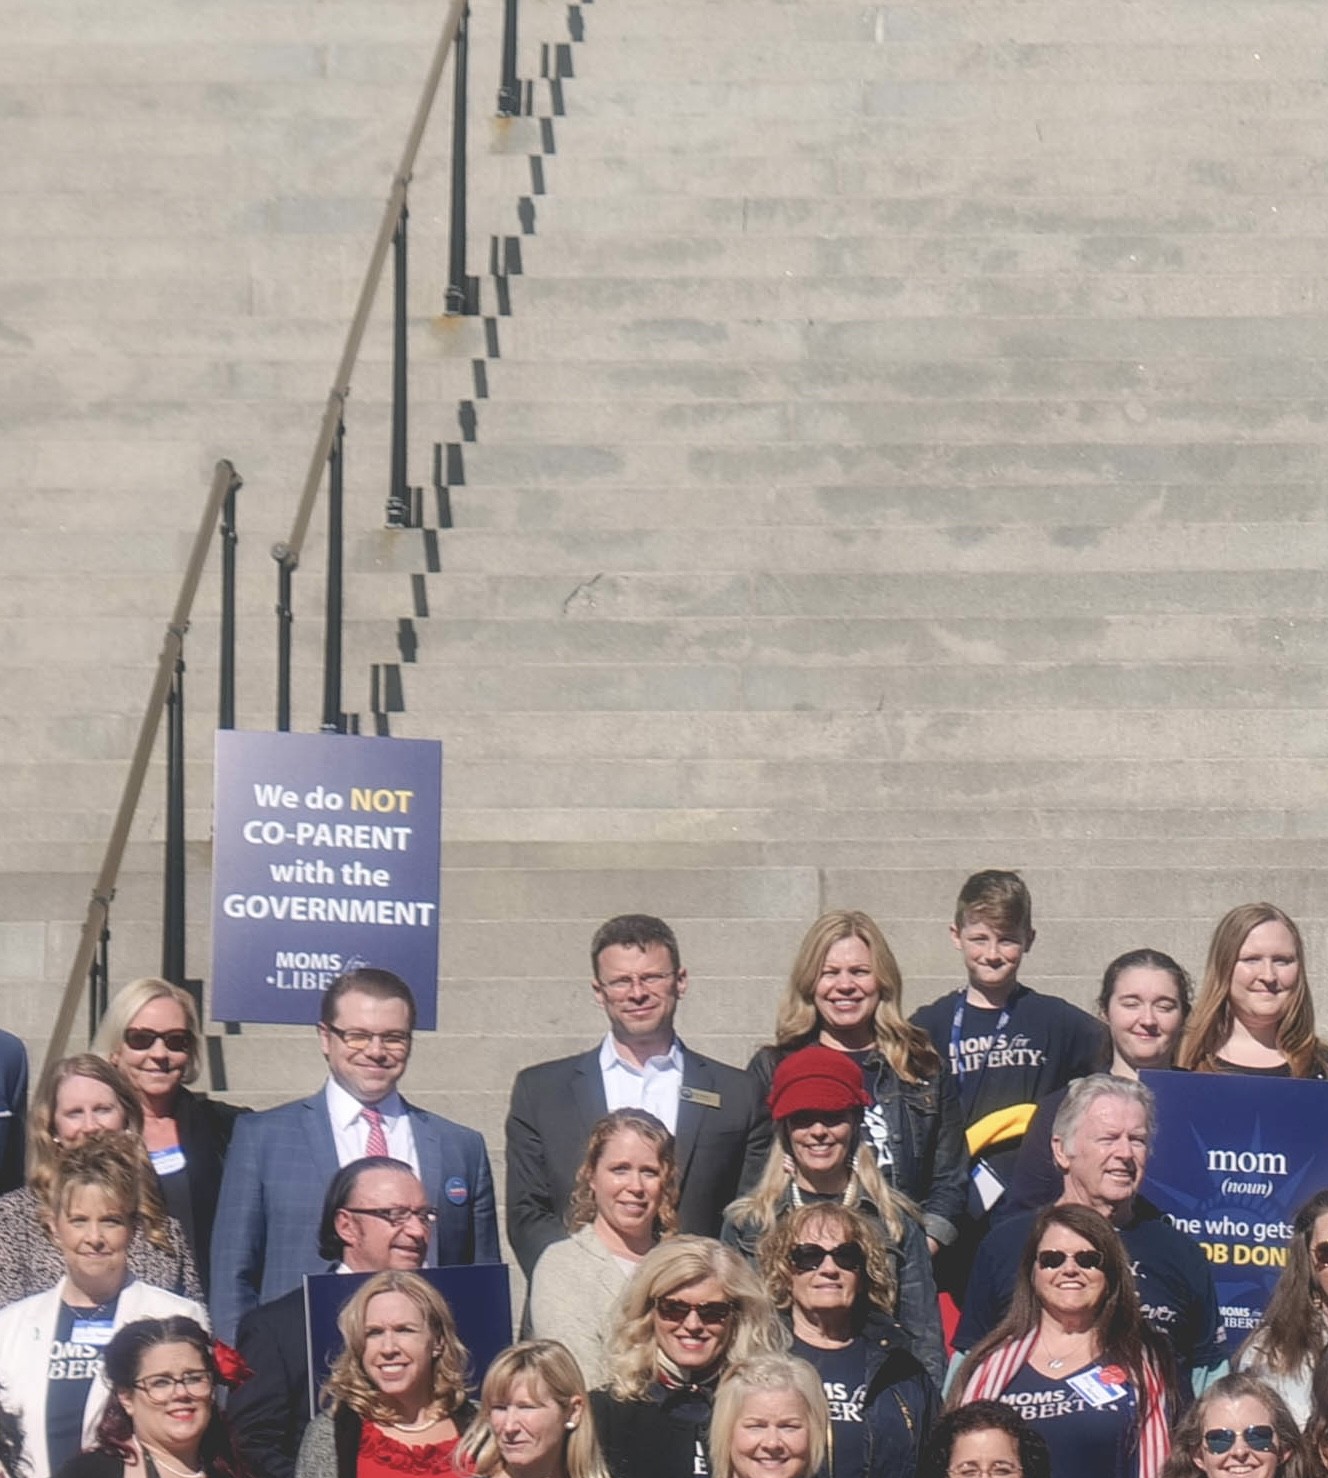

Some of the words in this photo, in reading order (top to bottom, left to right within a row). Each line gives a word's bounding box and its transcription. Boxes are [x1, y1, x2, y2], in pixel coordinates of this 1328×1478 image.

[254, 784, 302, 809] We
[305, 787, 343, 811] do
[350, 788, 414, 813] NOT
[243, 821, 412, 851] CO-PARENT
[270, 859, 335, 885] with
[340, 862, 390, 887] the
[223, 894, 435, 926] GOVERNMENT
[276, 951, 342, 971] MOMS
[276, 971, 340, 991] LIBE
[1207, 1150, 1287, 1175] mom
[1221, 1178, 1273, 1198] (noun)
[1205, 1216, 1249, 1238] who
[1253, 1220, 1294, 1243] gets
[1140, 1303, 1177, 1322] ever.
[1225, 1317, 1264, 1329] IBERT
[50, 1342, 97, 1359] OMS
[1000, 1389, 1065, 1407] MOMS
